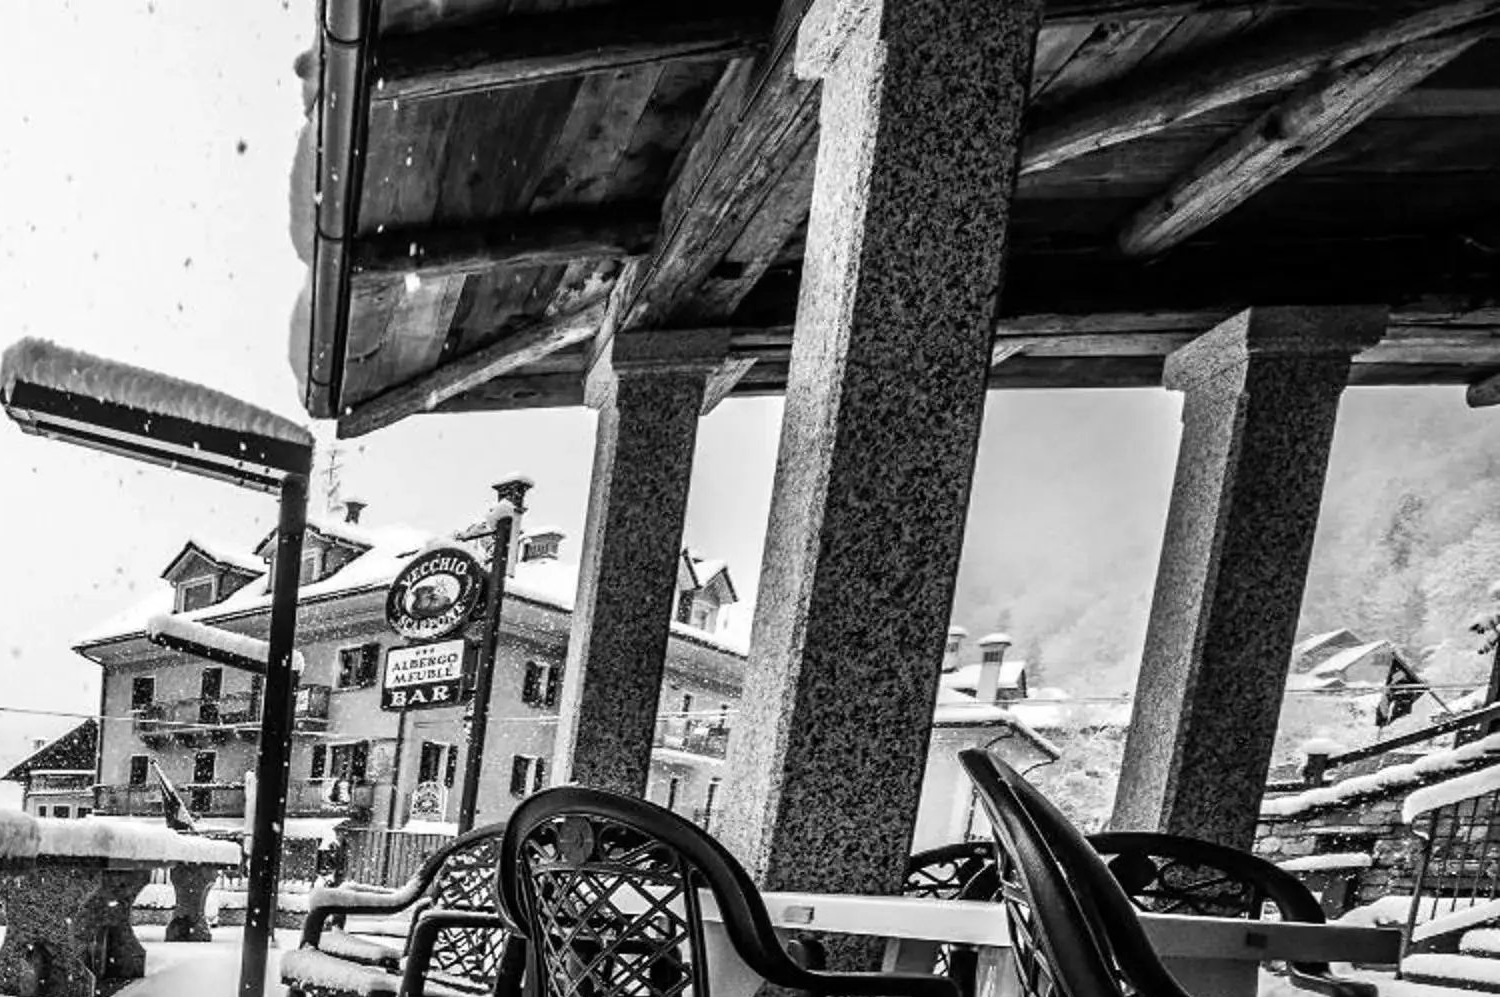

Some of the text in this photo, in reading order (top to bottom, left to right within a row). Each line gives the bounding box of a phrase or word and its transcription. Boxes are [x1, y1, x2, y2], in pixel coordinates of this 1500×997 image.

[400, 558, 467, 588] VECCHIO
[392, 653, 459, 672] ALBERGO
[389, 685, 450, 707] BAR
